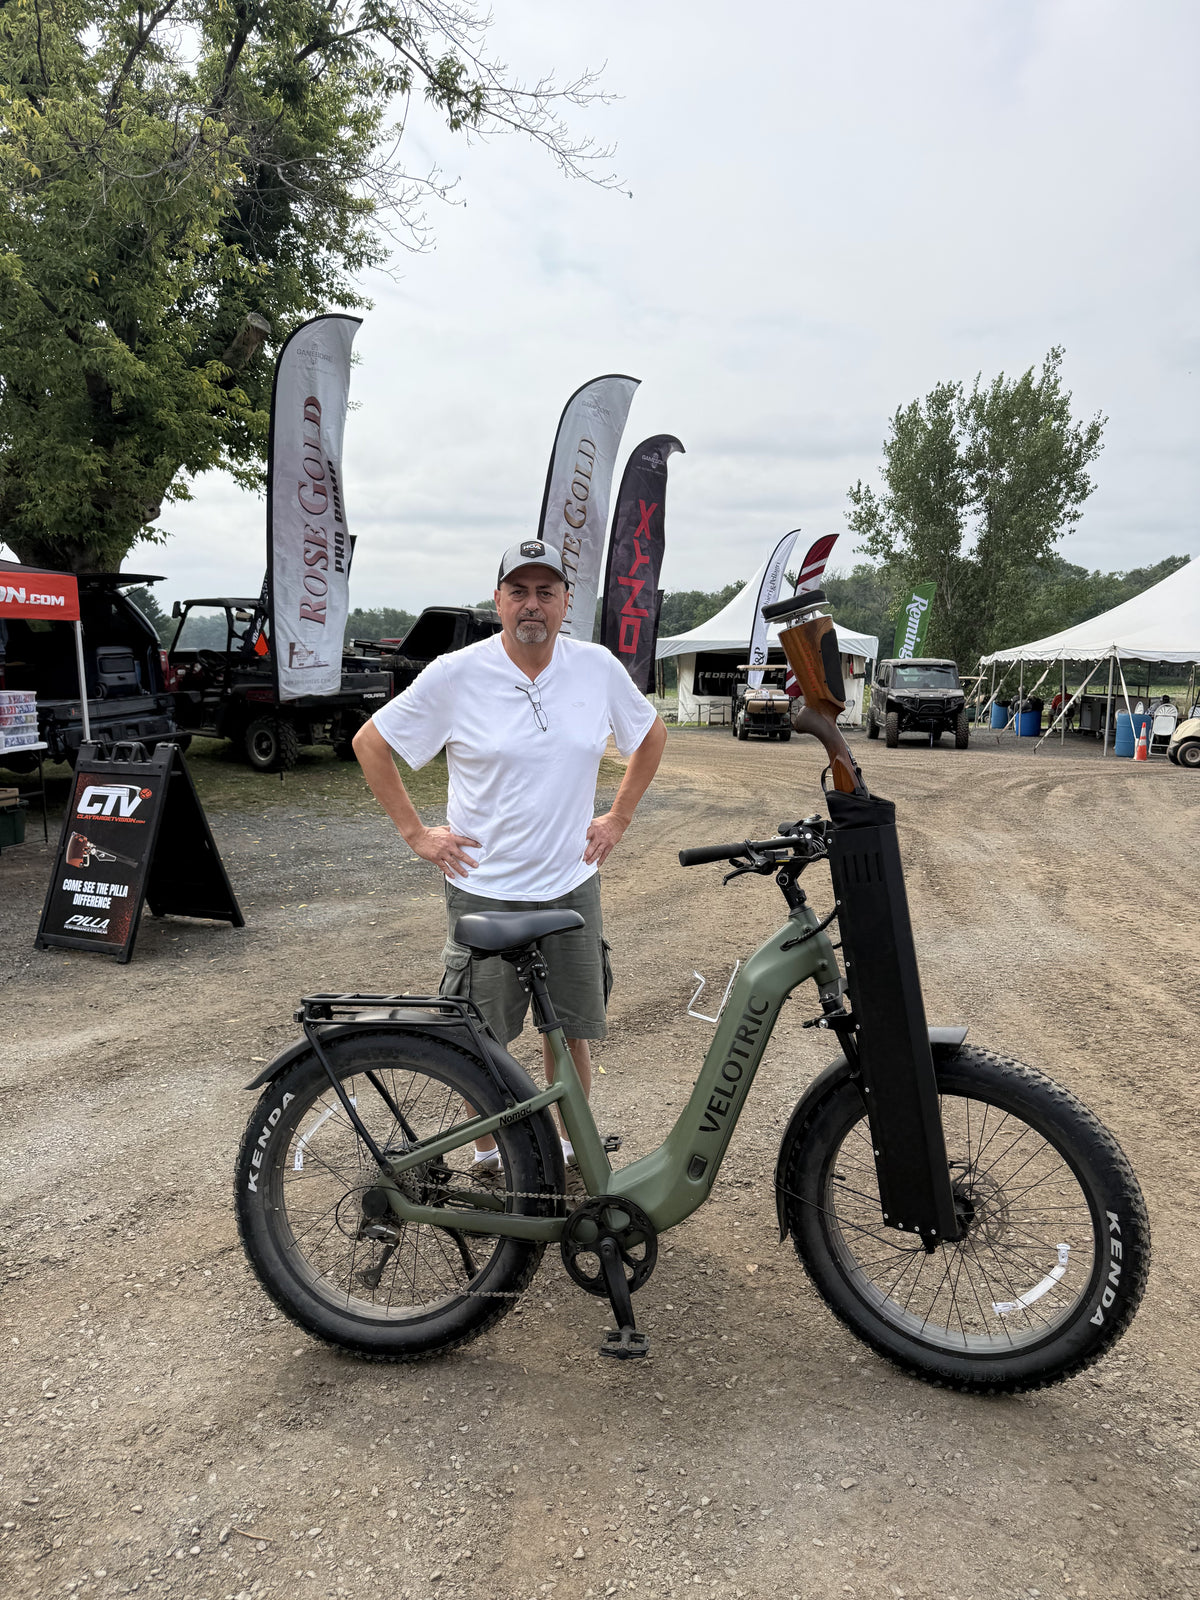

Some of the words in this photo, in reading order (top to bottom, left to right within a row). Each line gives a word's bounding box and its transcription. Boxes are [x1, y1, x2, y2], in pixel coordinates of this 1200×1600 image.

[297, 395, 329, 515] GOLD
[563, 437, 596, 529] GOLD
[299, 524, 329, 627] ROSE
[334, 532, 345, 574] PRO
[617, 499, 658, 654] ONYX
[899, 593, 928, 659] Reming
[77, 784, 142, 817] CTV
[62, 879, 83, 892] COME
[82, 881, 96, 894] SEE
[96, 882, 109, 895] THE
[109, 884, 128, 897] PILLA
[65, 914, 110, 929] PILLA
[72, 893, 112, 909] DIFFERENCE
[698, 995, 770, 1132] VELOTRIC
[248, 1092, 295, 1193] KENDA
[499, 1104, 532, 1126] Nomad
[1090, 1210, 1123, 1326] KENDA
